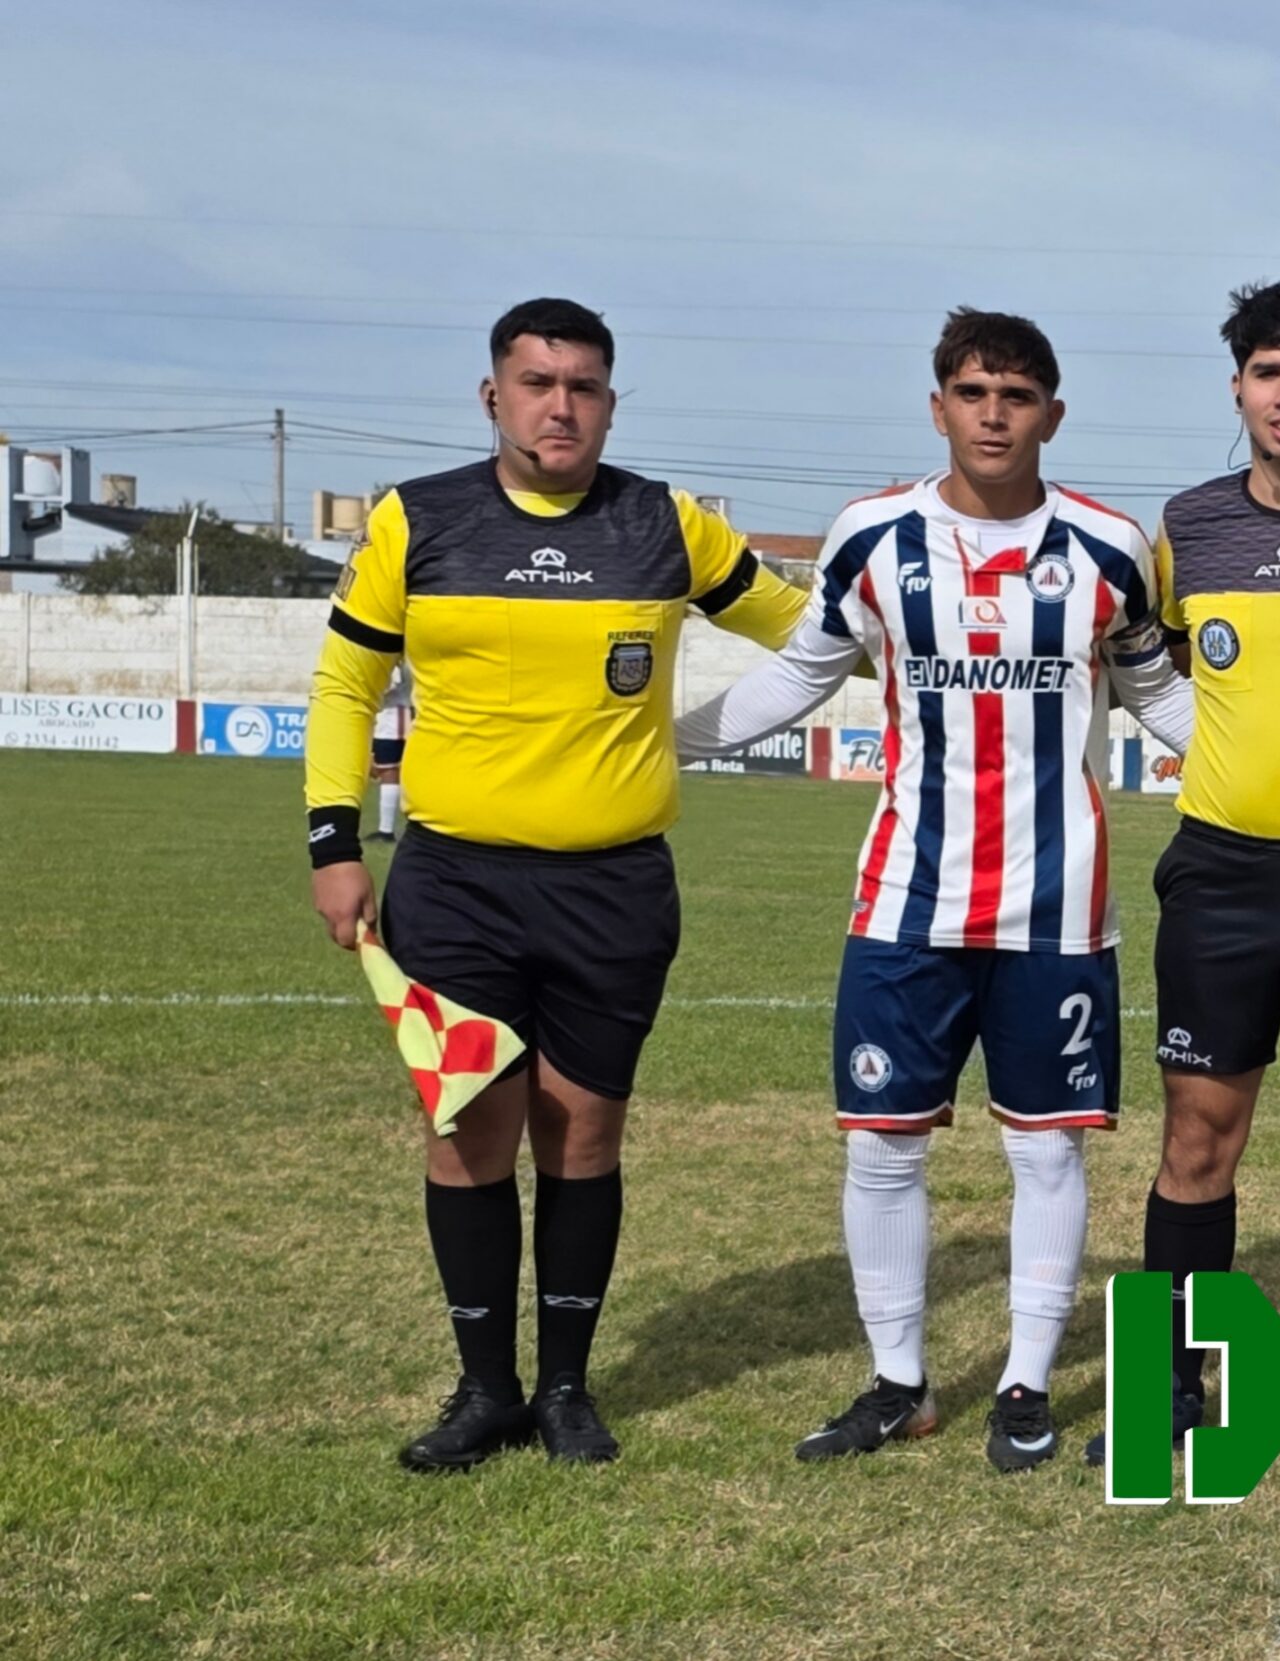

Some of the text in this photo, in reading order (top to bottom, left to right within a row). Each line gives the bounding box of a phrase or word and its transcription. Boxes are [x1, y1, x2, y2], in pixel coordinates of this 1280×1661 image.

[504, 568, 595, 583] ATHIX
[933, 658, 1074, 690] DANOMET
[67, 701, 164, 720] GACCIO
[1059, 992, 1092, 1056] 2
